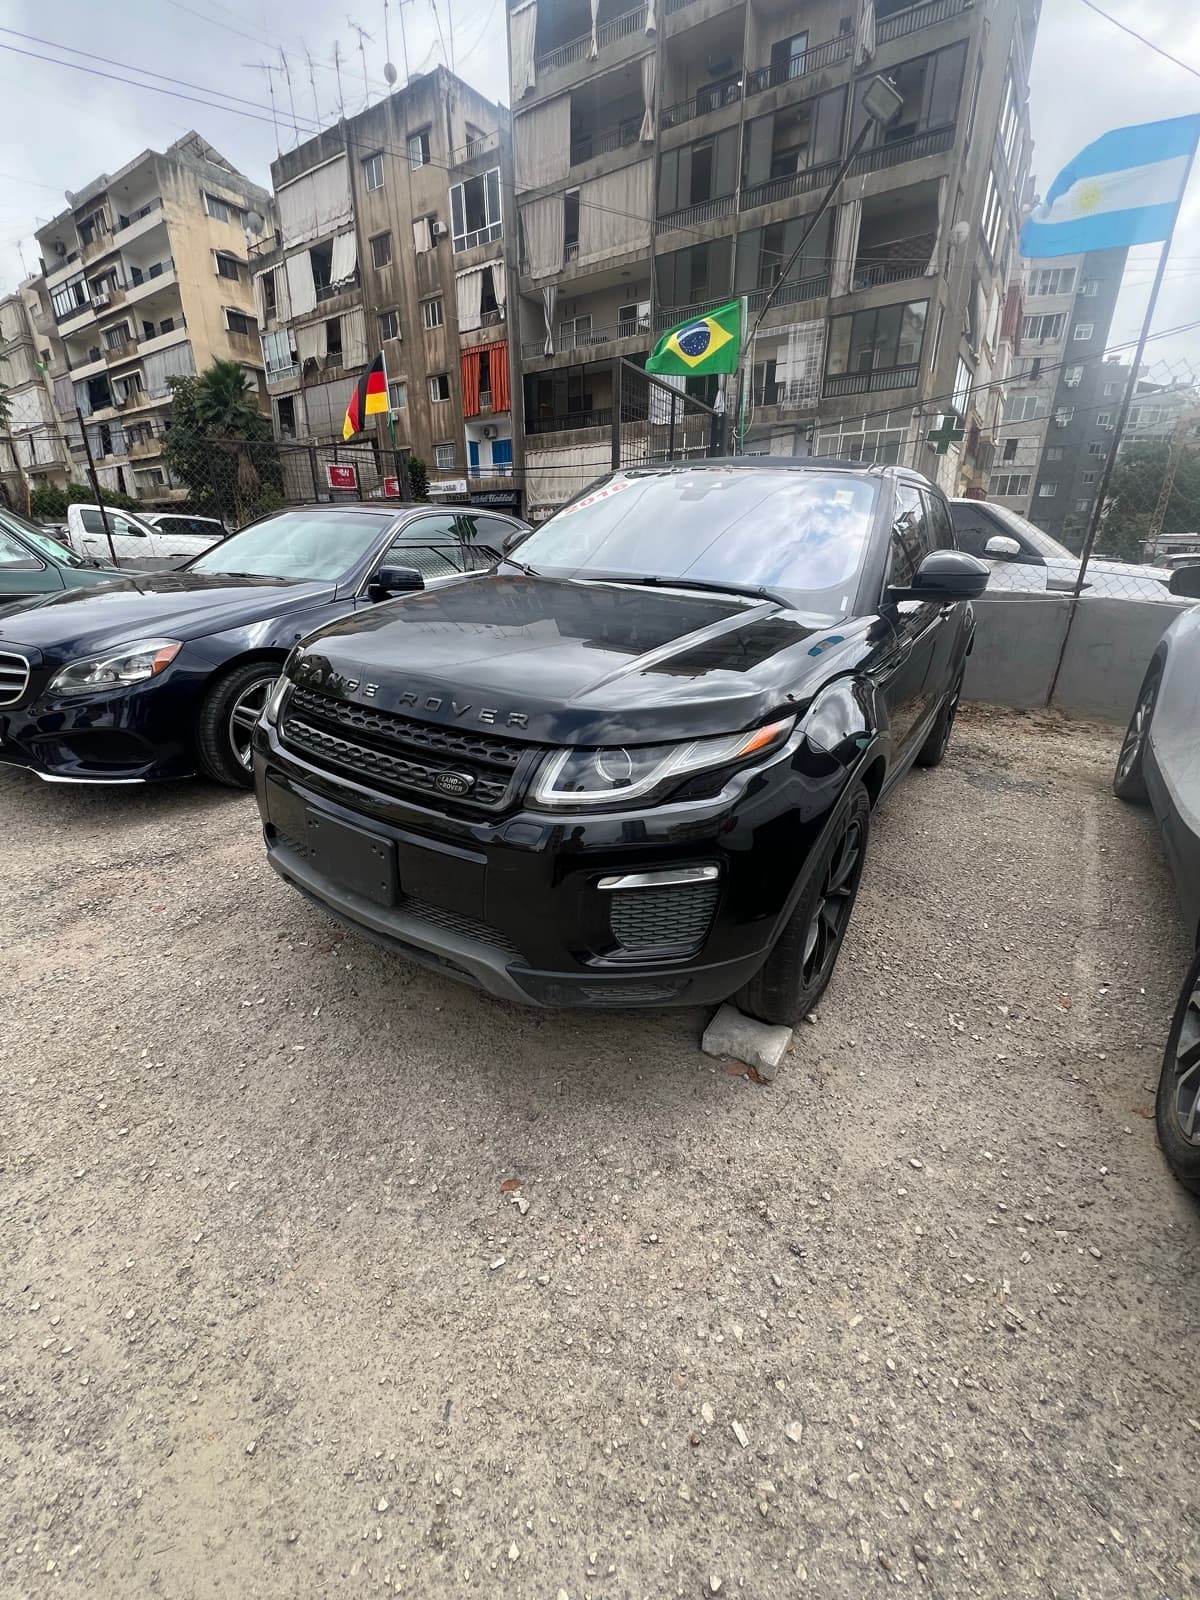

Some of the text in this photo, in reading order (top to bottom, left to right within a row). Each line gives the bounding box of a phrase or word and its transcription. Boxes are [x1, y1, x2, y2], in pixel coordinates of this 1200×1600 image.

[300, 663, 529, 730] RANGE ROVER
[441, 775, 458, 785] LAND
[442, 782, 463, 793] ROVER
